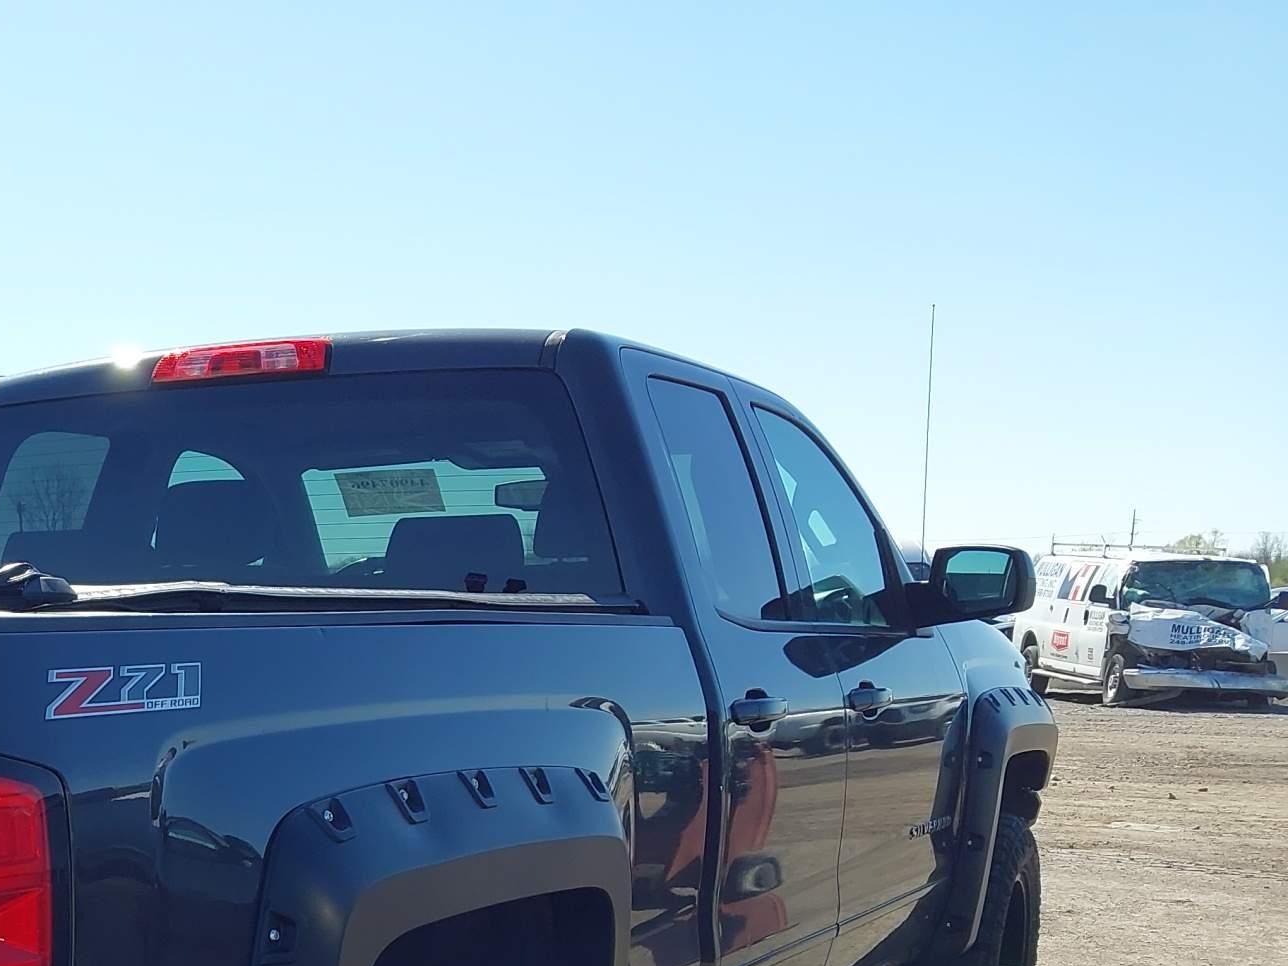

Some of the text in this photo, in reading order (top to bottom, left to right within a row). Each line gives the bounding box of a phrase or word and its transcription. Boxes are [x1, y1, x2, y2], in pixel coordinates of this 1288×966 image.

[45, 662, 201, 720] Z71
[146, 698, 200, 710] OFF ROAD
